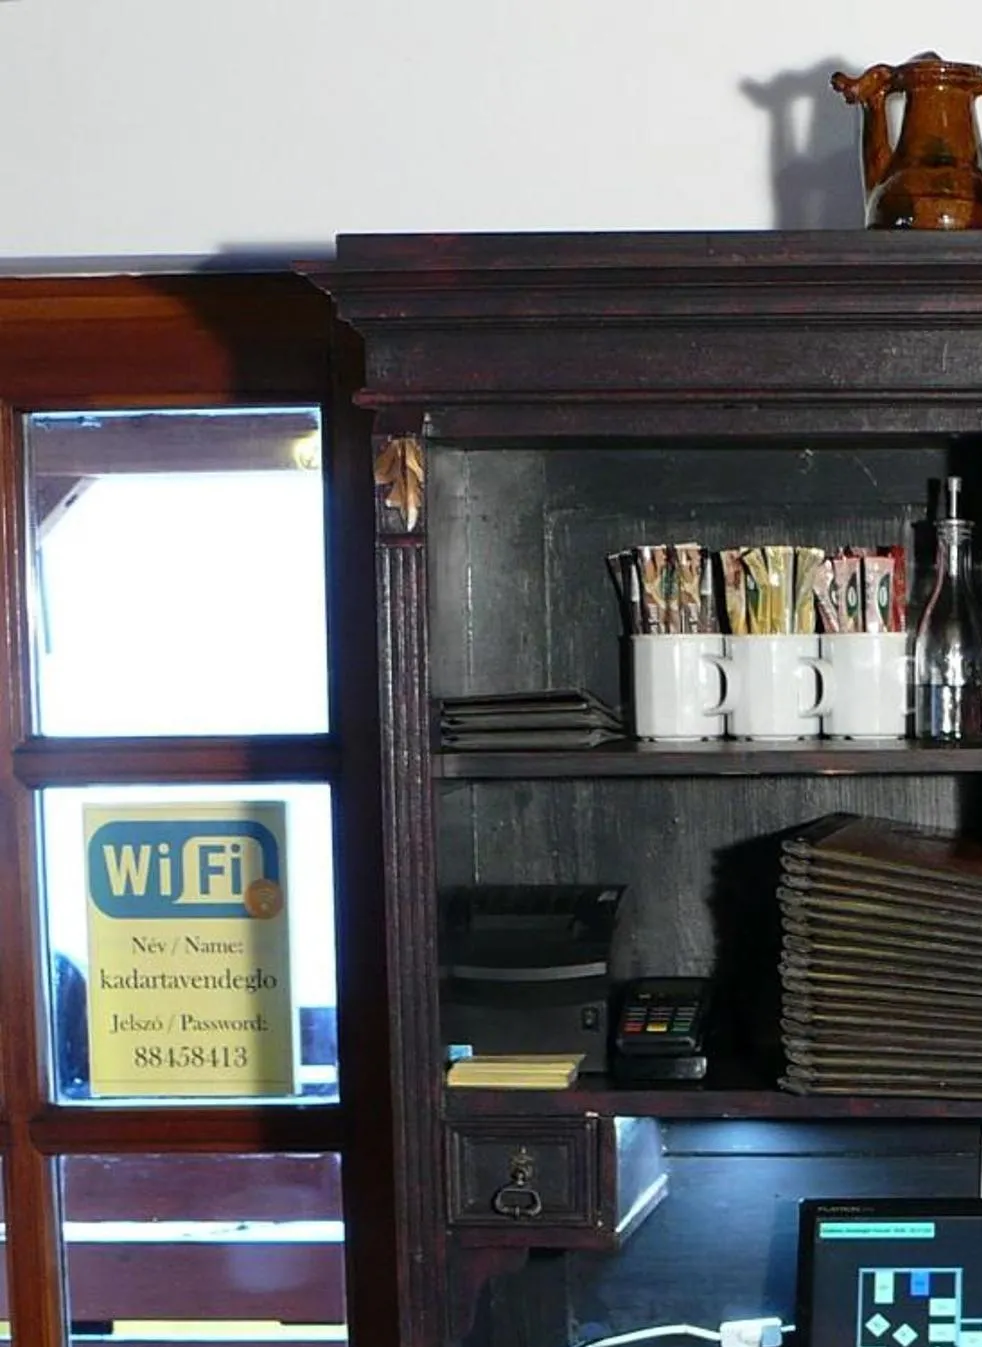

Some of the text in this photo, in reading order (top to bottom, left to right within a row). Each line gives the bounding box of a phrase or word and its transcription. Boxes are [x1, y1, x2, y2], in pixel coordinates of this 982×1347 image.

[132, 936, 167, 954] Név
[185, 936, 244, 954] Name:
[99, 968, 278, 993] kadartavendeglo
[110, 1013, 163, 1034] Jelszó
[180, 1013, 268, 1032] Password:
[134, 1047, 248, 1068] 88458413
